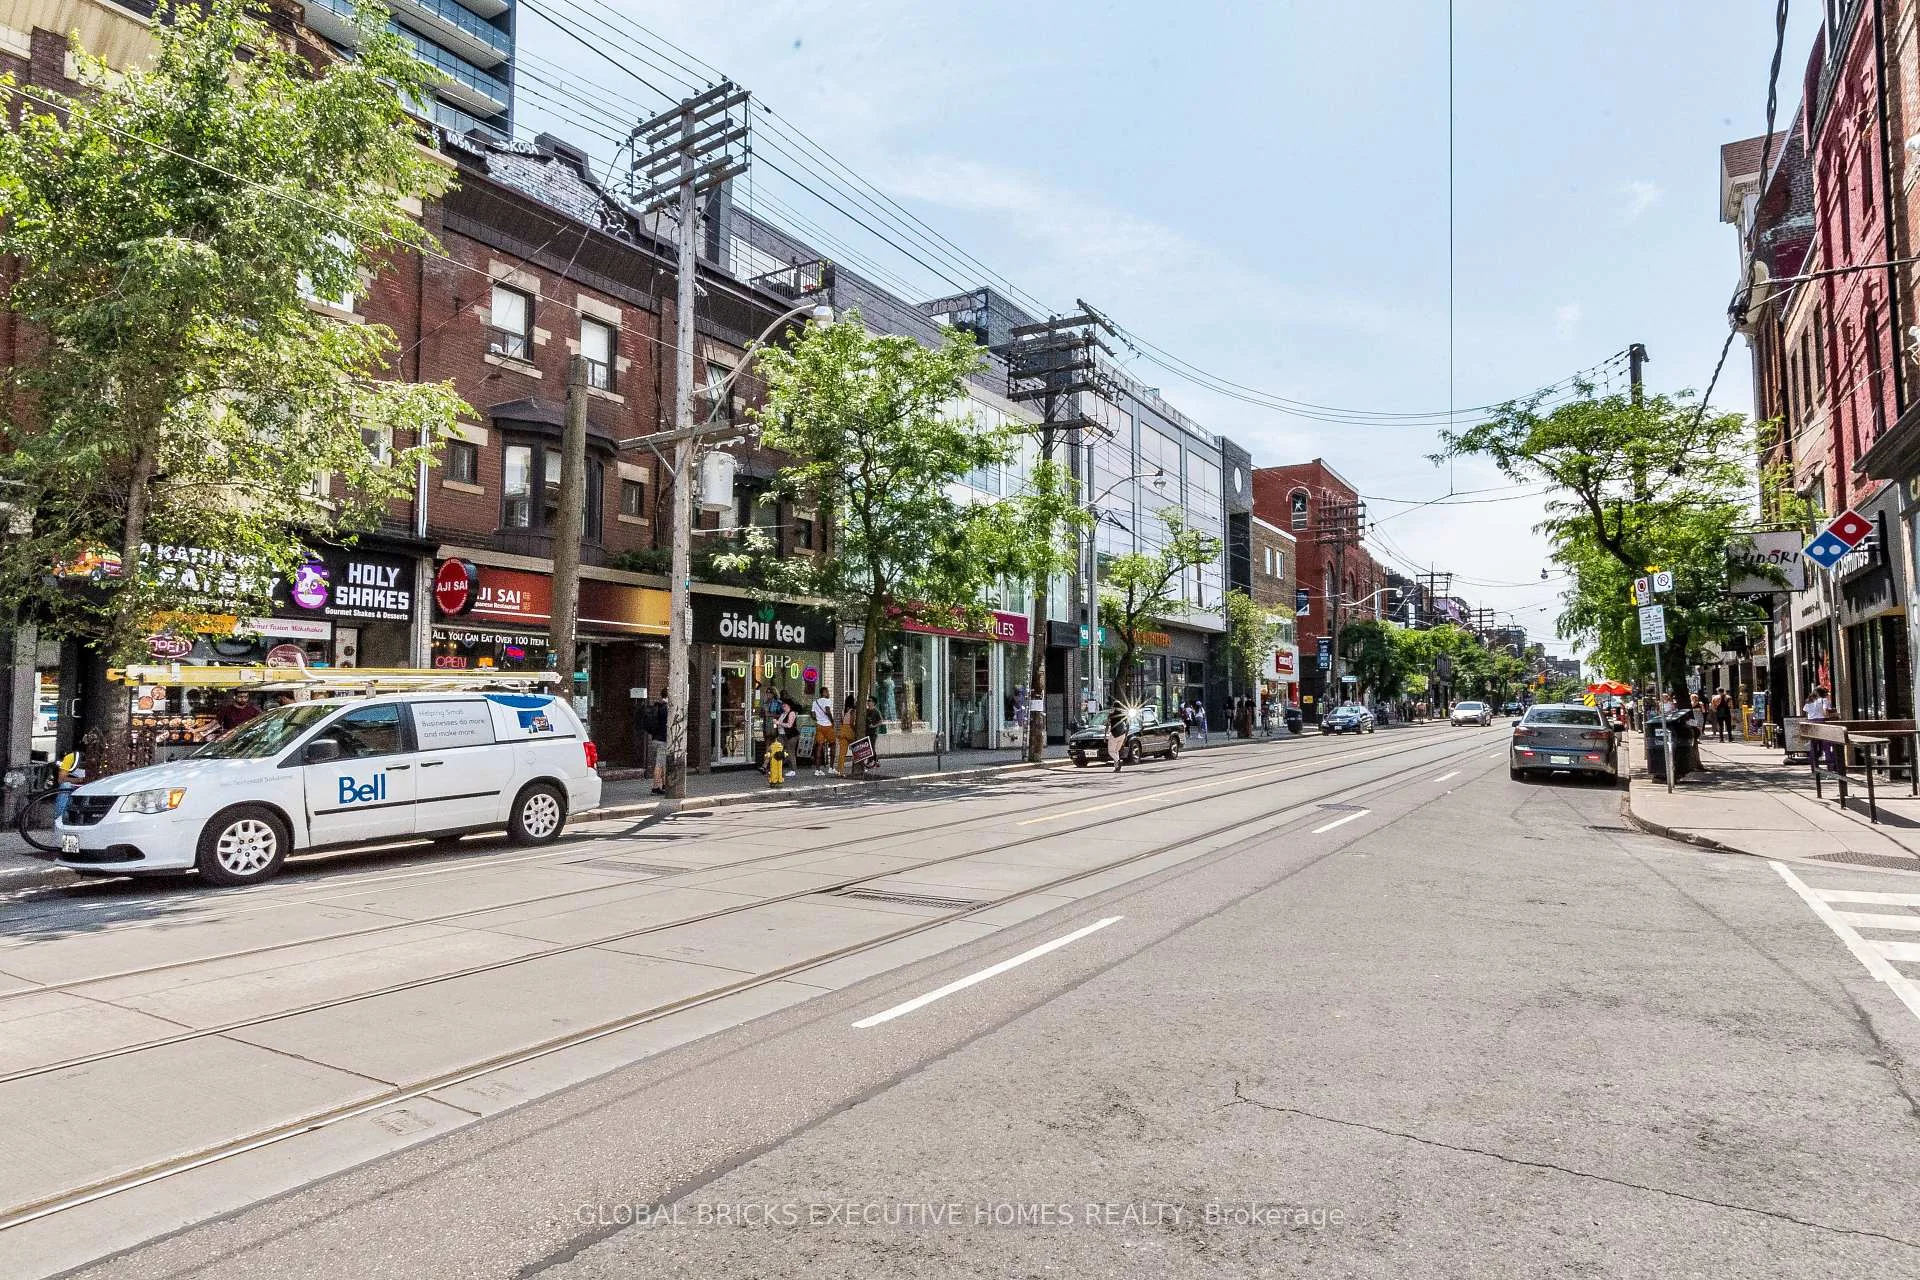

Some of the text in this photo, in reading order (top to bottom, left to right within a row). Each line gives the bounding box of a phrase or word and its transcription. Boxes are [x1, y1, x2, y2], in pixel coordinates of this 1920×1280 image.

[348, 562, 400, 588] HOLY
[436, 580, 468, 592] AJI SAI
[335, 586, 409, 610] SHAKES
[476, 587, 492, 601] JI
[497, 588, 521, 604] SAI
[325, 607, 352, 616] Gourmet
[353, 609, 375, 618] Shakes
[383, 612, 408, 620] Desserts
[432, 629, 446, 640] ALL
[448, 631, 463, 641] YOU
[464, 632, 479, 642] CAN
[481, 633, 493, 643] EAT
[495, 634, 512, 645] OVER
[515, 636, 528, 645] 100
[529, 637, 545, 646] ITEM
[775, 620, 806, 644] tea
[435, 656, 467, 668] OPEN
[423, 730, 437, 738] and
[438, 729, 456, 737] make
[338, 773, 386, 804] Bell
